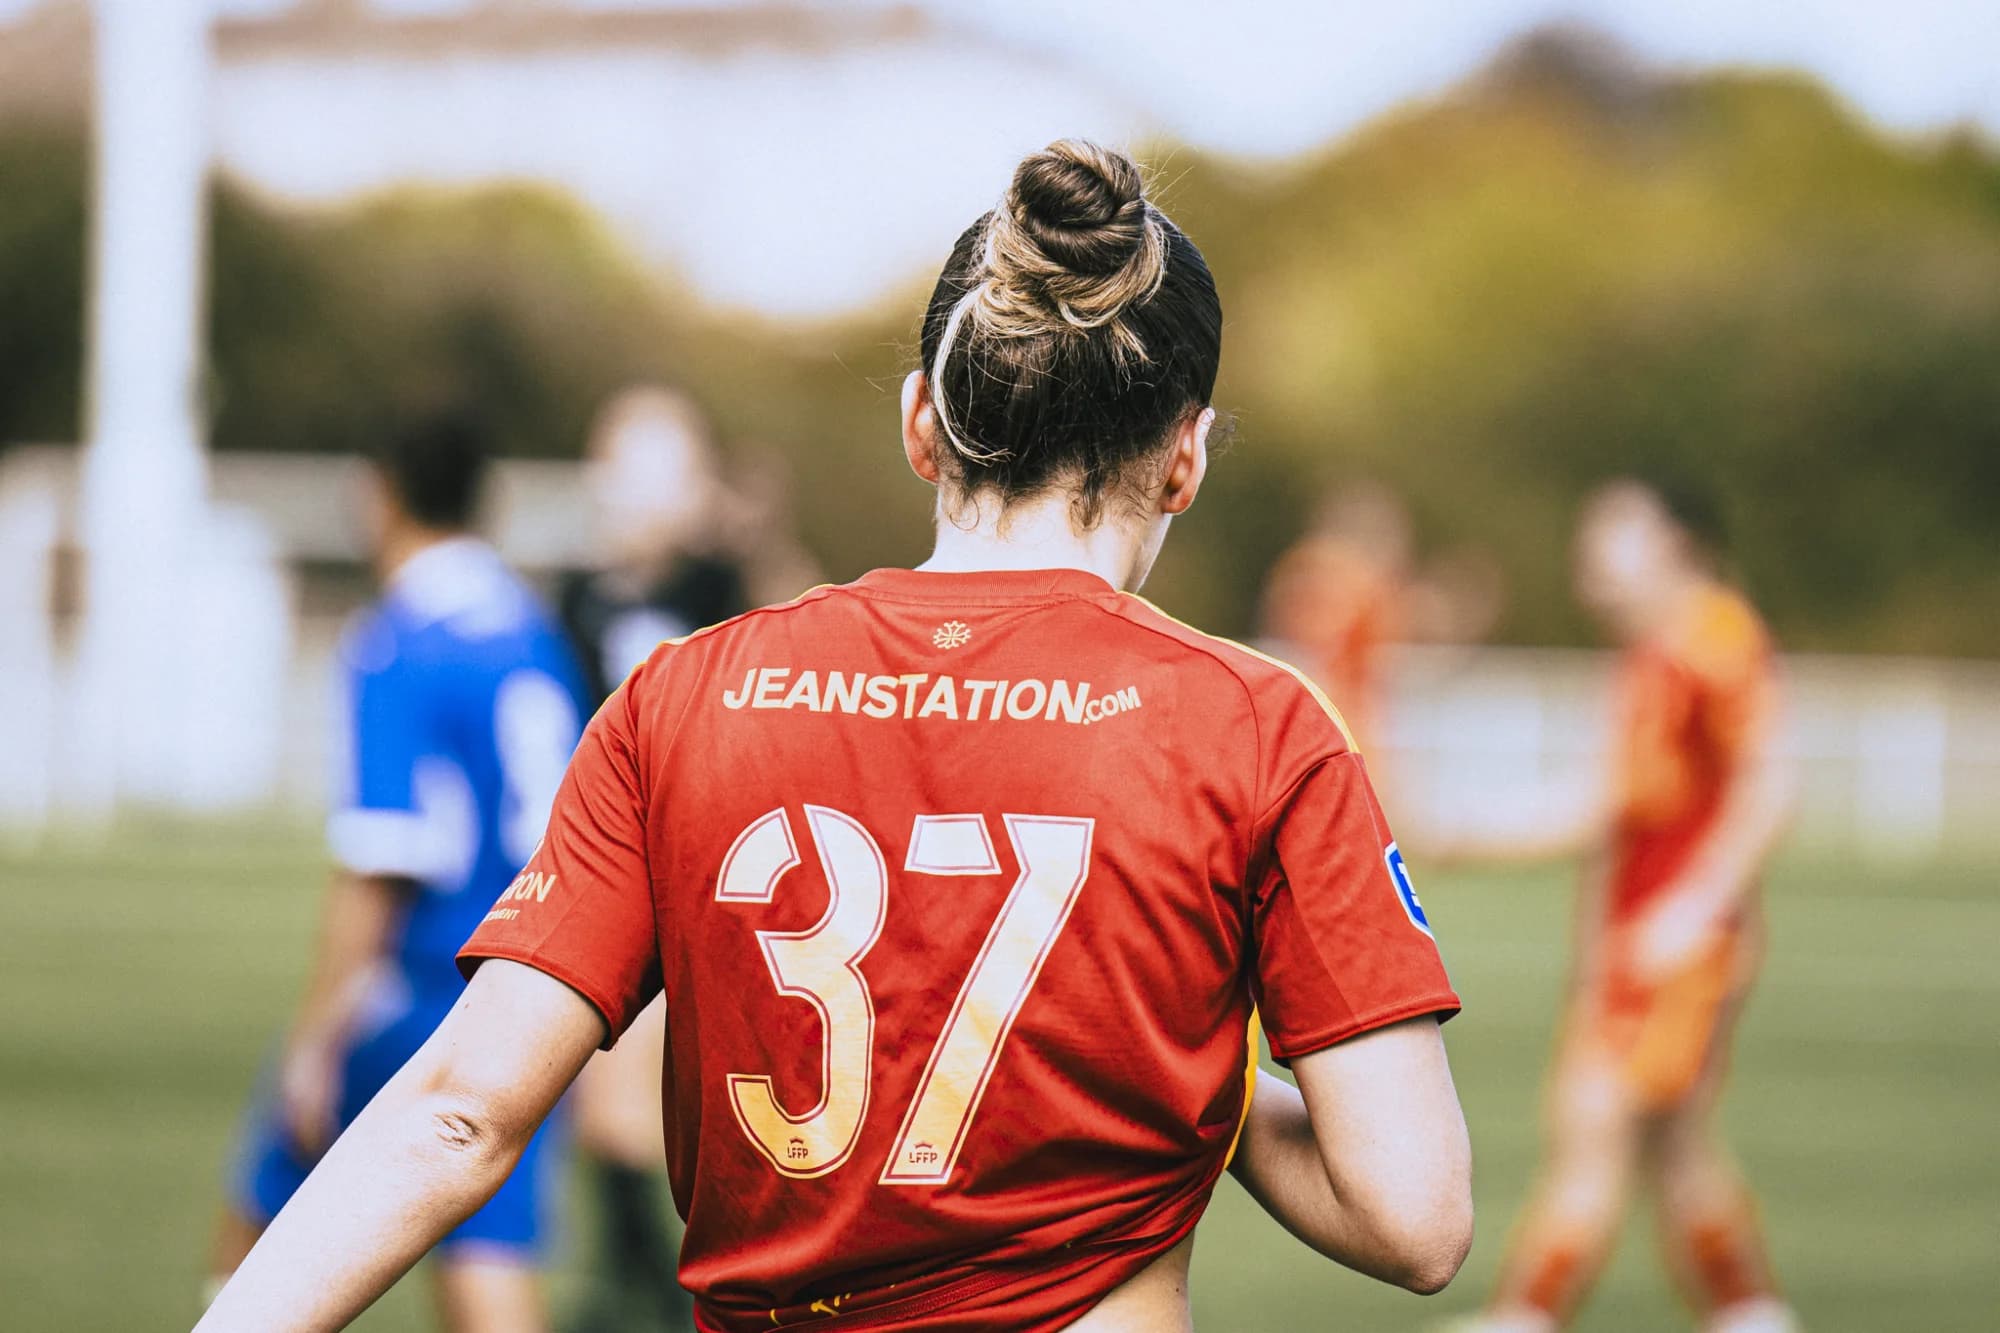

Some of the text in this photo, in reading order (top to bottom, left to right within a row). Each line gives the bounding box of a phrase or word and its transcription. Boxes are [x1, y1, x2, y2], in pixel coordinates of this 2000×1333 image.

[722, 667, 1142, 726] JEANSTATION.COM
[714, 803, 1096, 1186] 37
[909, 1151, 938, 1164] LFFP
